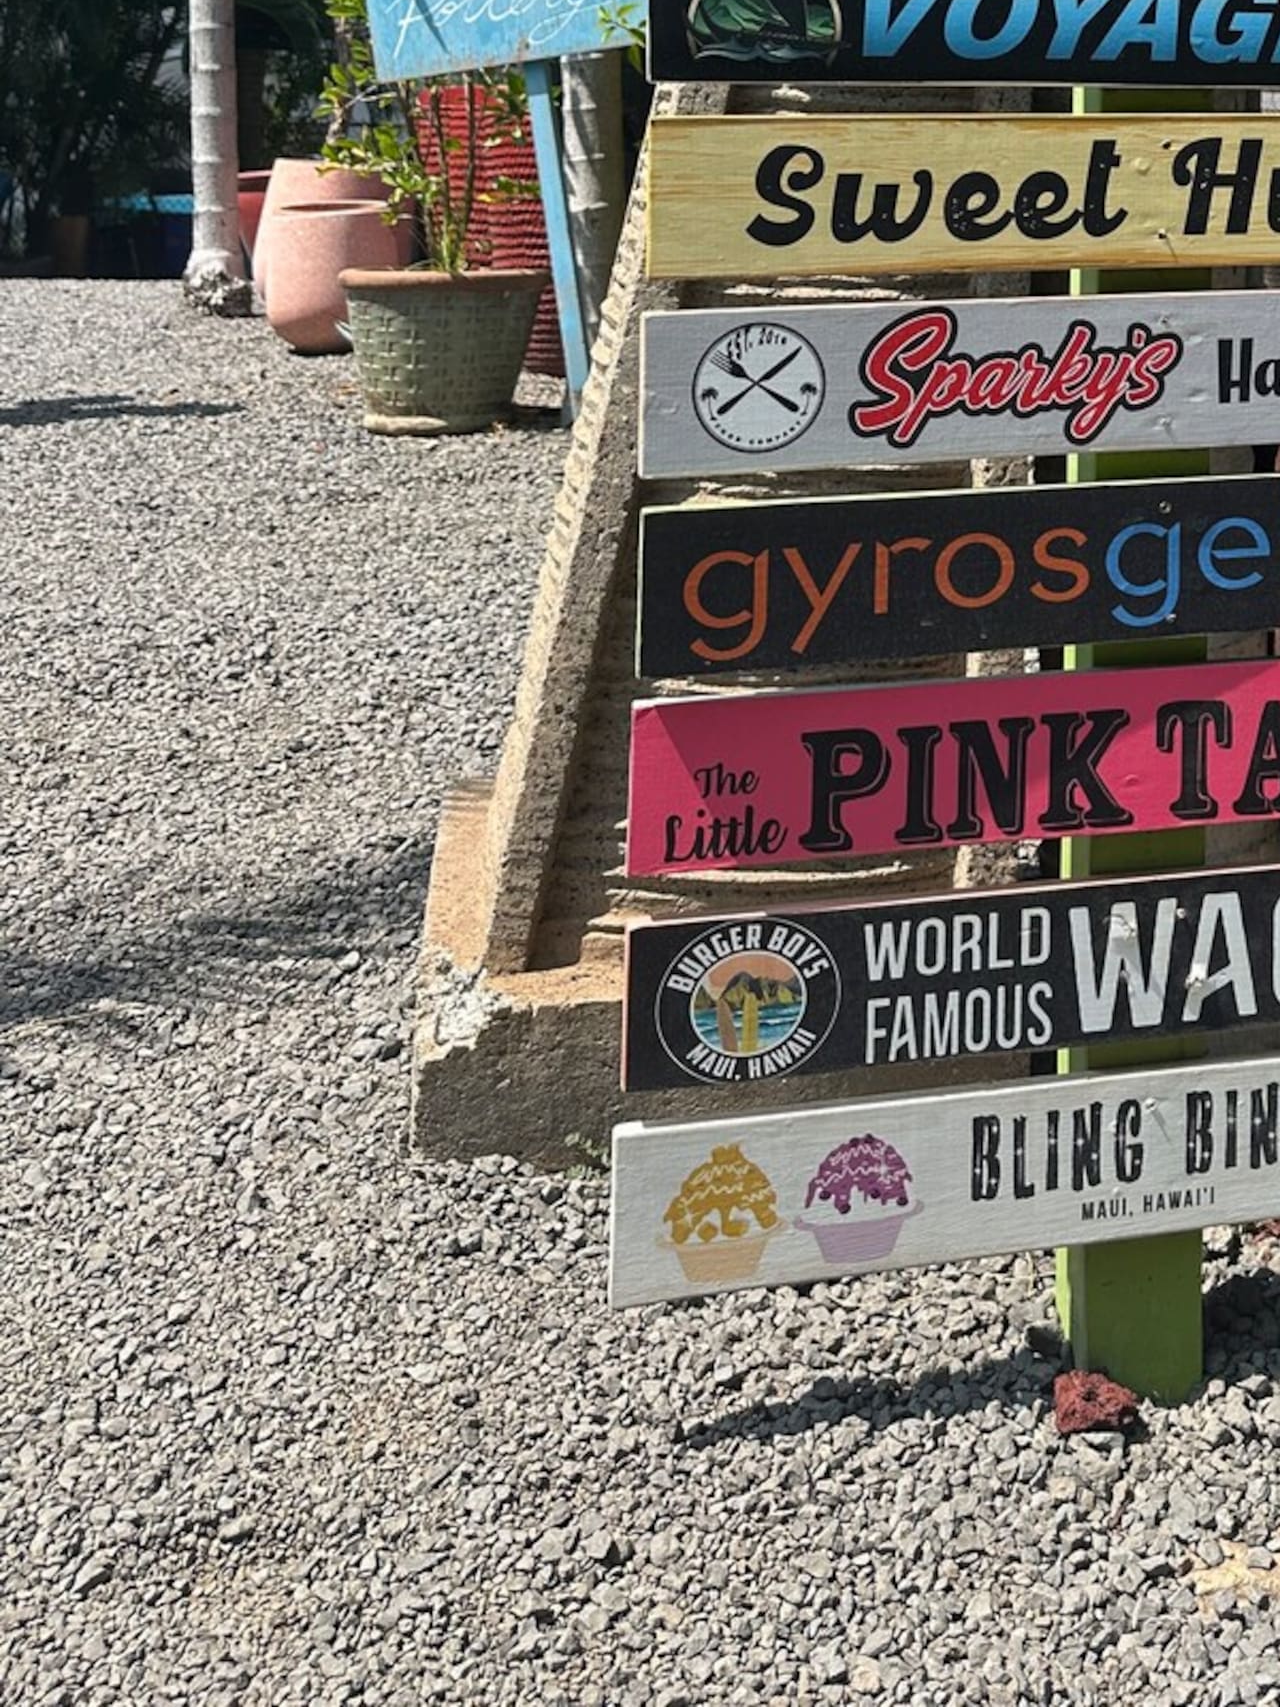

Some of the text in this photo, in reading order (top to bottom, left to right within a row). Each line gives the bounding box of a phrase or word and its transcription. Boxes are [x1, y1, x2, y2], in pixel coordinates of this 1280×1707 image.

[744, 138, 1128, 248] Sweet
[849, 306, 1182, 448] Sparky's
[694, 762, 758, 800] The
[800, 708, 1132, 852] PINK
[664, 807, 787, 862] Little
[666, 924, 830, 994] BURGER BOYS
[862, 906, 1052, 982] WORLD
[685, 1027, 817, 1081] MAUI, HAWAII
[864, 981, 1054, 1065] FAMOUS
[970, 1099, 1144, 1202] BLING
[1080, 1186, 1216, 1222] MAUI, HAWAI'I
